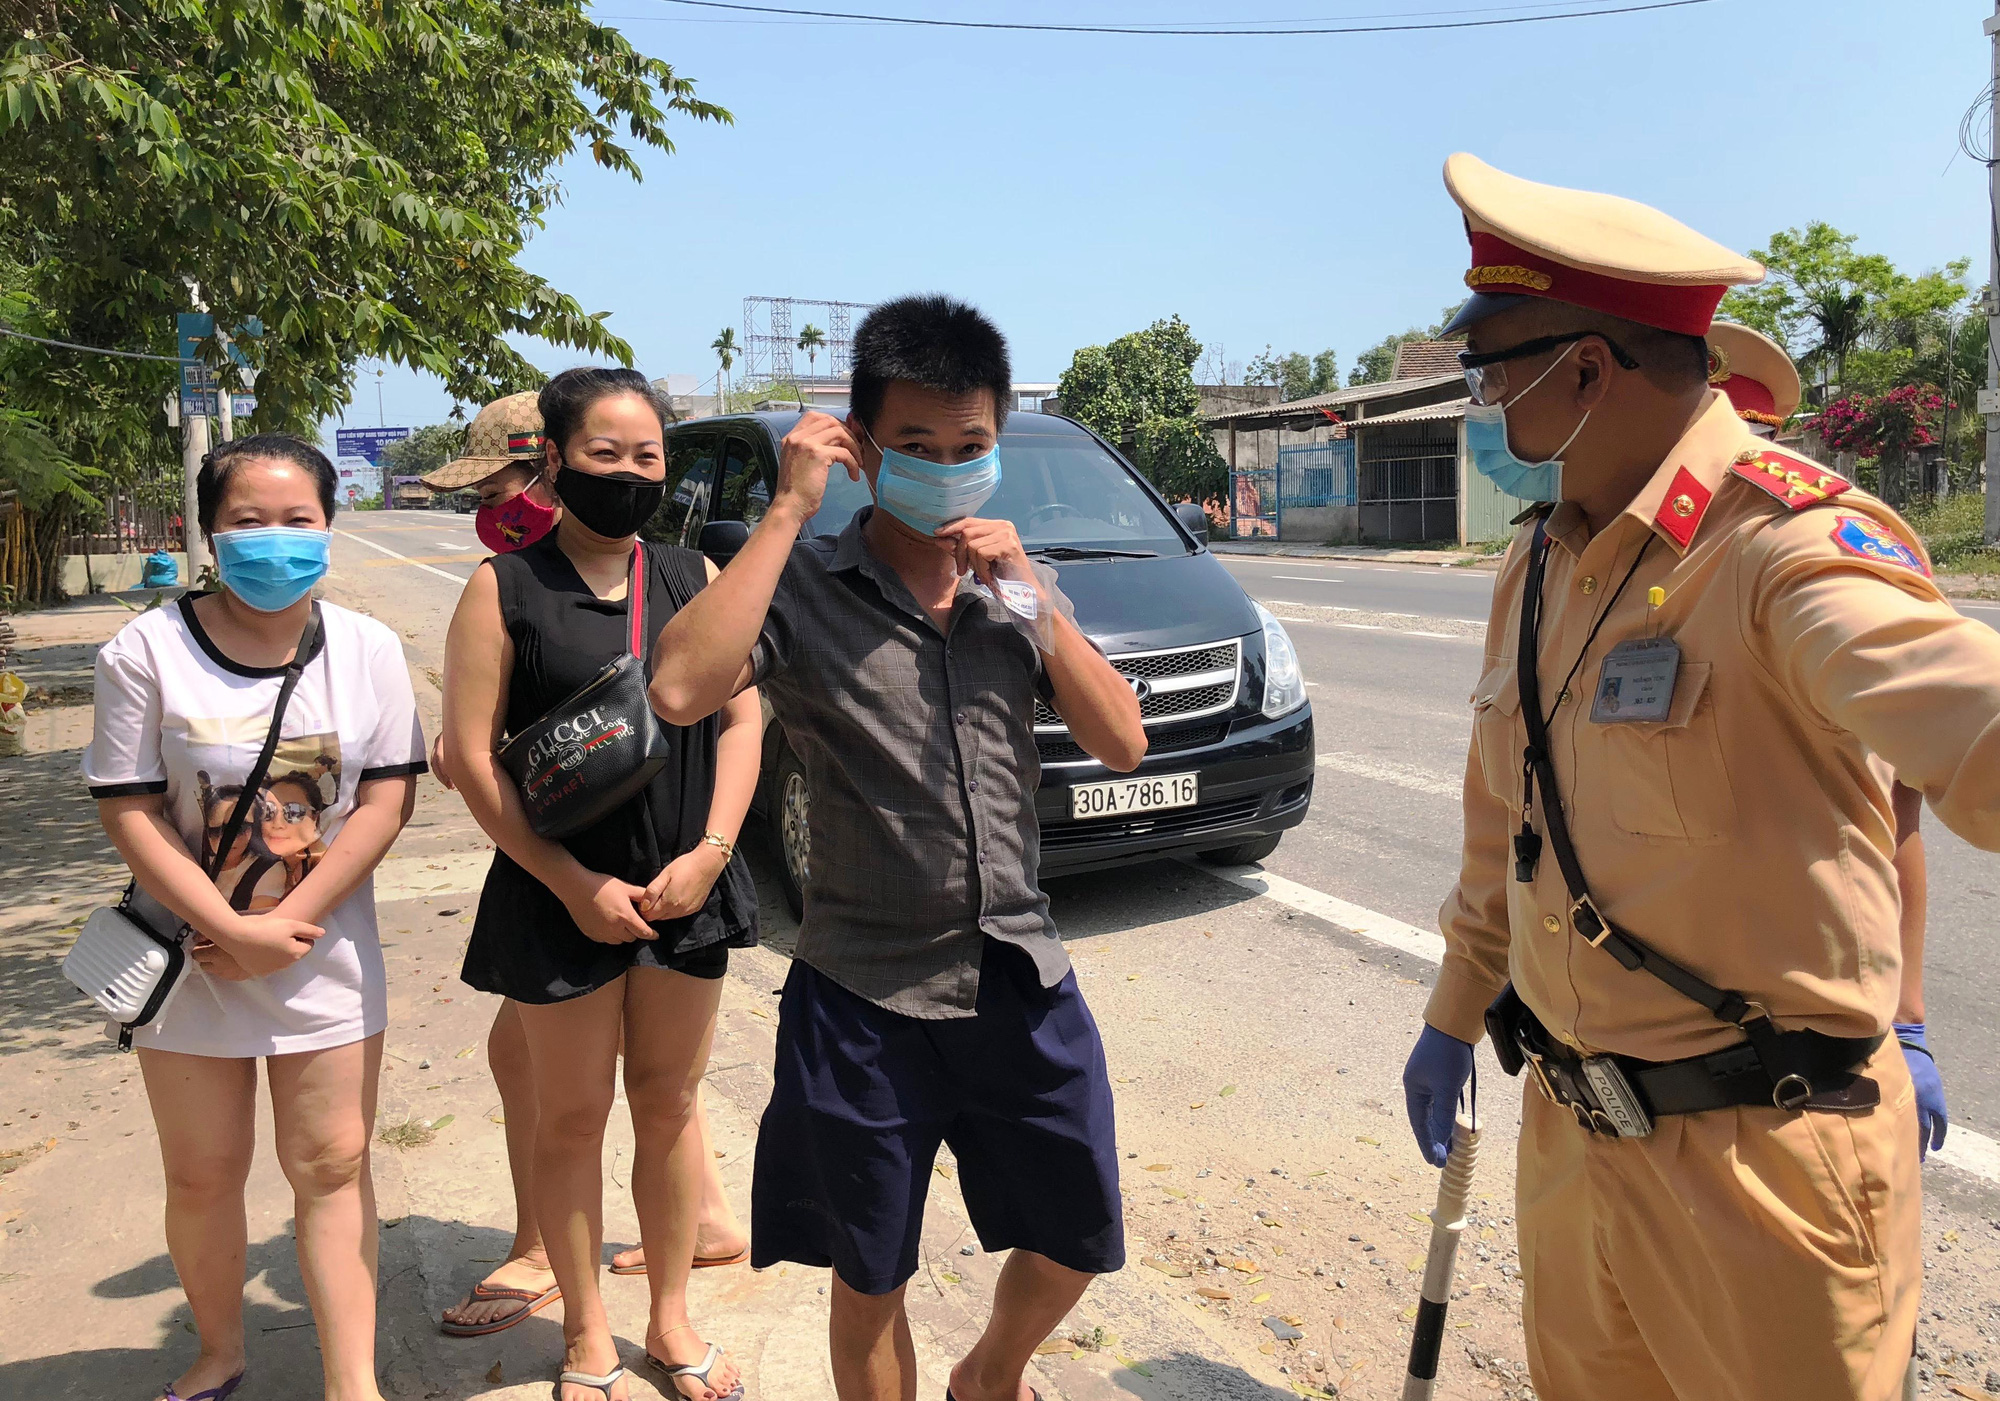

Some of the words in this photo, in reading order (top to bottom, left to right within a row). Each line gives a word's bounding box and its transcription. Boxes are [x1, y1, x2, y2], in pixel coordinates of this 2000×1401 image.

[522, 764, 540, 787] WHAT
[545, 742, 565, 762] ARE
[570, 730, 591, 742] WE
[527, 791, 538, 802] TO
[542, 775, 553, 787] DO
[589, 739, 611, 753] ALL
[613, 725, 635, 741] THIS
[528, 707, 605, 766] GUCCI
[1077, 778, 1193, 814] 30A-786.16
[1593, 1076, 1633, 1129] POLICE
